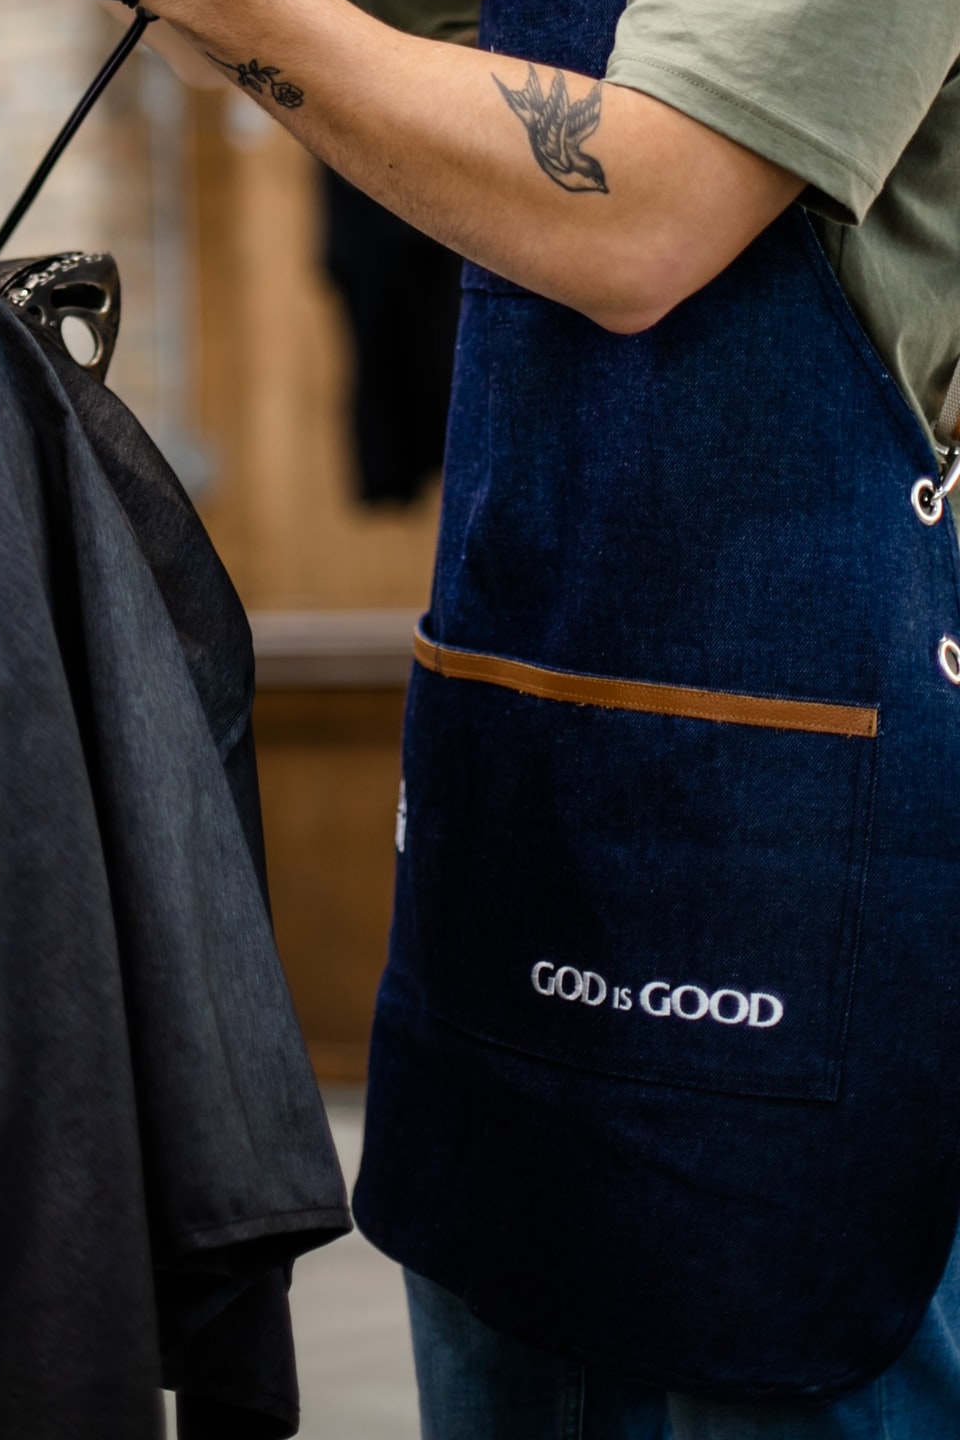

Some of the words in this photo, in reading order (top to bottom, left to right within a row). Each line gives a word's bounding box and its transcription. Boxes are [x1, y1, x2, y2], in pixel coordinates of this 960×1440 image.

[532, 961, 606, 1005] GOD
[613, 987, 632, 1010] IS
[640, 982, 783, 1027] GOOD
